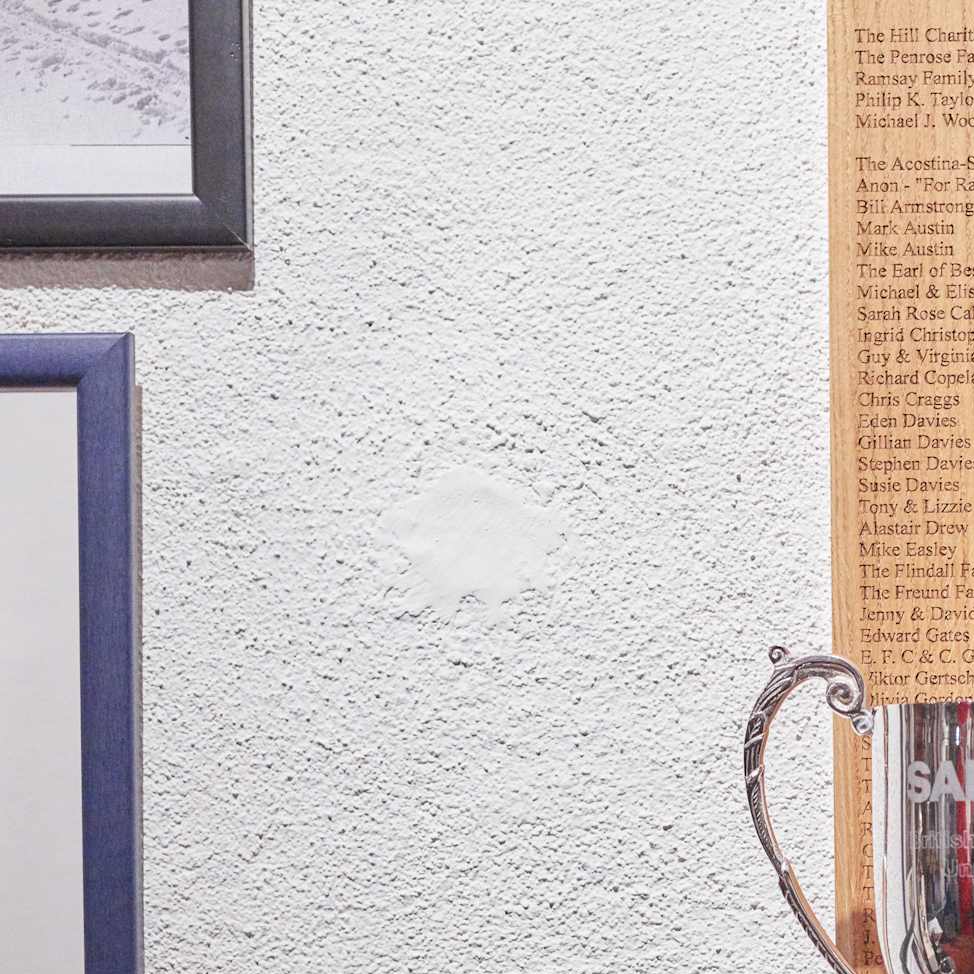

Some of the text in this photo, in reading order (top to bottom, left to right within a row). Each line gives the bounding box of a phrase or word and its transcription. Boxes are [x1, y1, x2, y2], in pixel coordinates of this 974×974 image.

[855, 28, 884, 43] The
[890, 28, 918, 42] Hill
[856, 50, 884, 64] The
[890, 50, 951, 64] Penrose
[856, 93, 901, 109] Philip
[907, 93, 924, 107] K.
[856, 114, 917, 128] Michael
[924, 114, 935, 128] J.
[856, 200, 974, 216] Bill Armstrong
[857, 221, 954, 235] Mark Austin
[857, 307, 900, 321] Sarah
[906, 306, 945, 320] Rose
[857, 328, 904, 345] Ingrid
[858, 414, 957, 428] Eden Davies
[859, 457, 920, 474] Stephen
[859, 521, 968, 535] Alastair Drew
[859, 542, 956, 559] Mike Easley
[861, 628, 969, 642] Edward Gates
